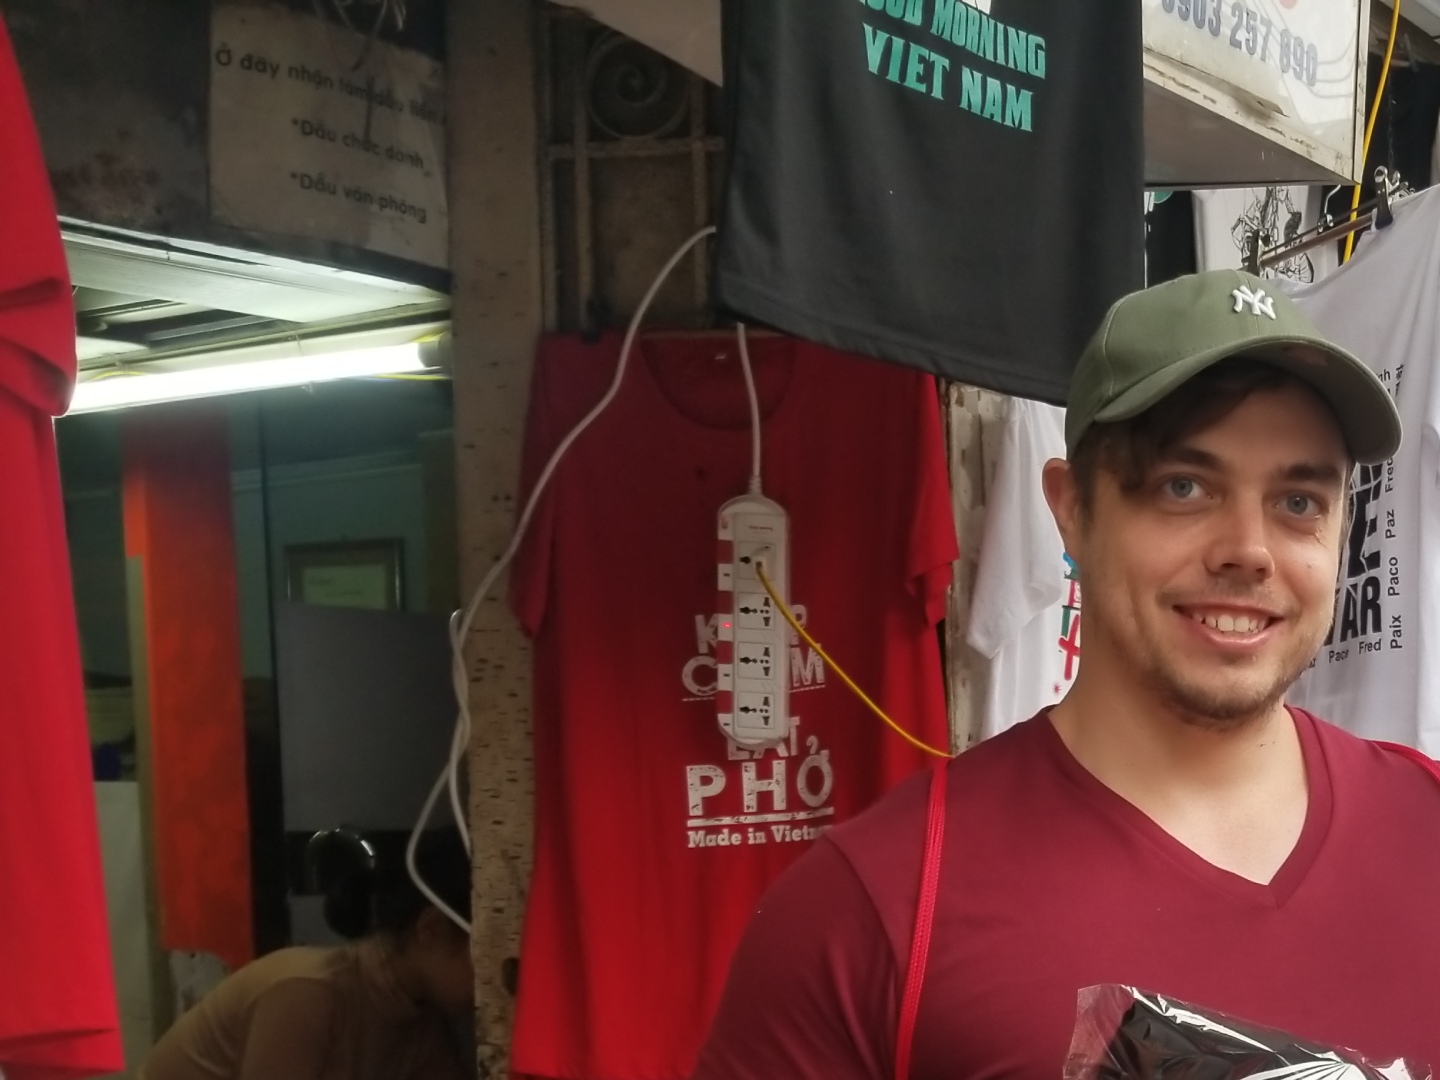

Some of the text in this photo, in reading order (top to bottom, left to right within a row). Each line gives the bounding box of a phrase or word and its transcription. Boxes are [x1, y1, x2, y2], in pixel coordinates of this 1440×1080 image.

[930, 0, 1046, 79] MORNING
[1229, 1, 1272, 62] 257
[1279, 28, 1318, 87] 890
[862, 22, 1034, 132] VIET NAM
[1385, 508, 1396, 540] Paz
[1387, 556, 1401, 597] Paco
[694, 603, 808, 655] KP
[1358, 638, 1382, 655] Fred
[1390, 614, 1403, 650] Paix
[681, 642, 826, 696] CM
[687, 828, 742, 848] Made
[748, 828, 767, 844] in
